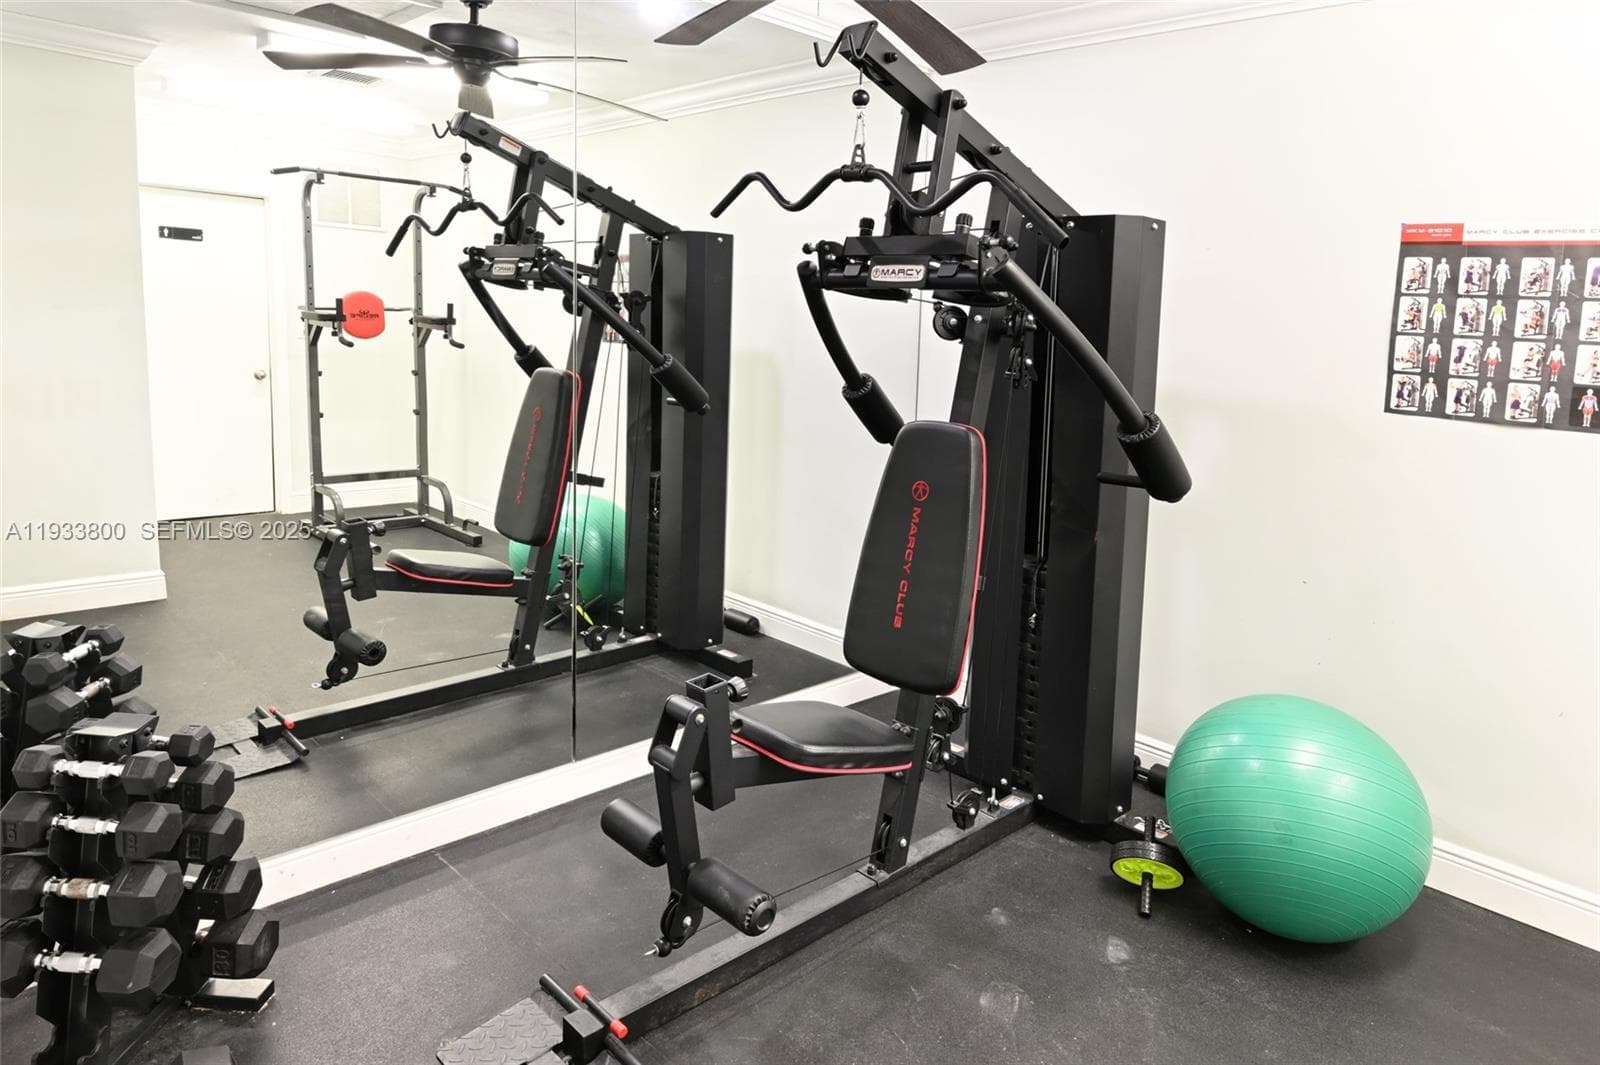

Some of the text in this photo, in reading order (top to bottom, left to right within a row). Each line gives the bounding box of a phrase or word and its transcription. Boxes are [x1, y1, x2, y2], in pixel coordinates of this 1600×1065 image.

[880, 268, 922, 276] MARCY
[893, 506, 922, 629] MARCY CLUB
